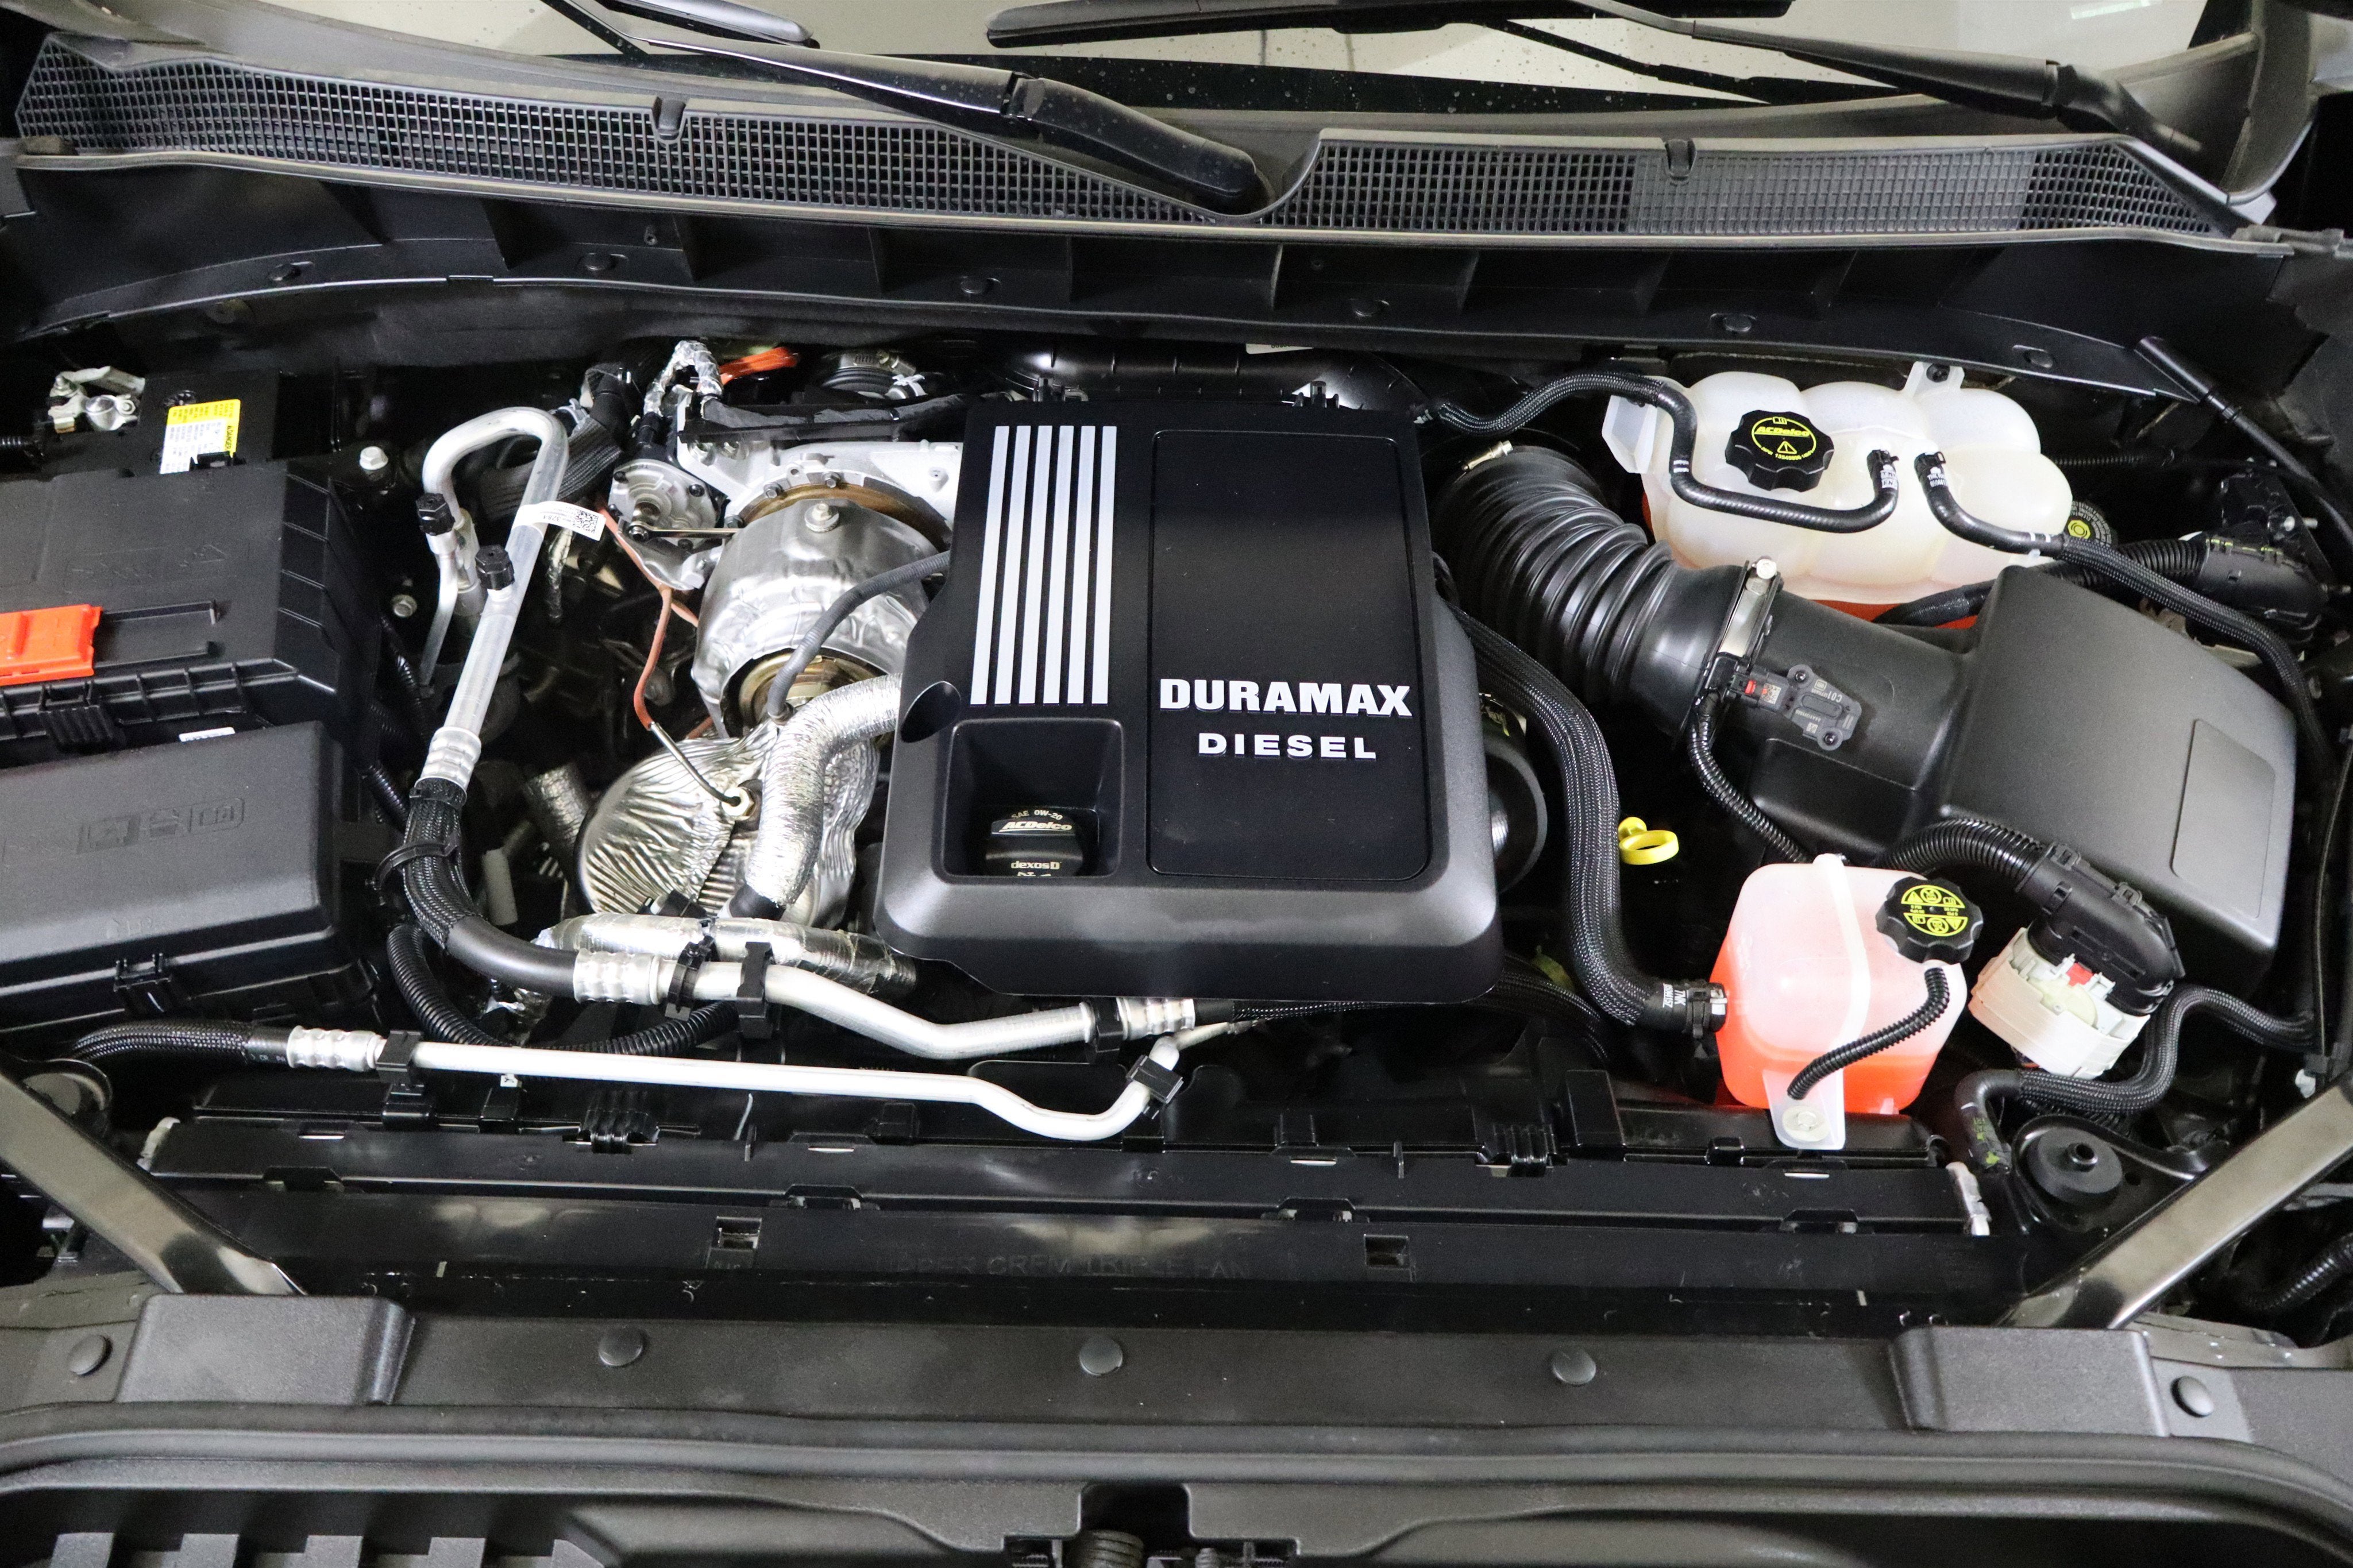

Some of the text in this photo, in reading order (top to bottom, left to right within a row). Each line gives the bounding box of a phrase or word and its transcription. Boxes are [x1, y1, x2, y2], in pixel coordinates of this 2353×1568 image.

[1754, 426, 1810, 437] ACDelco
[1160, 678, 1413, 717] DURAMAX
[1198, 732, 1376, 759] DIESEL
[1011, 809, 1063, 820] SAE 0W-20
[1002, 821, 1073, 831] ACDelco
